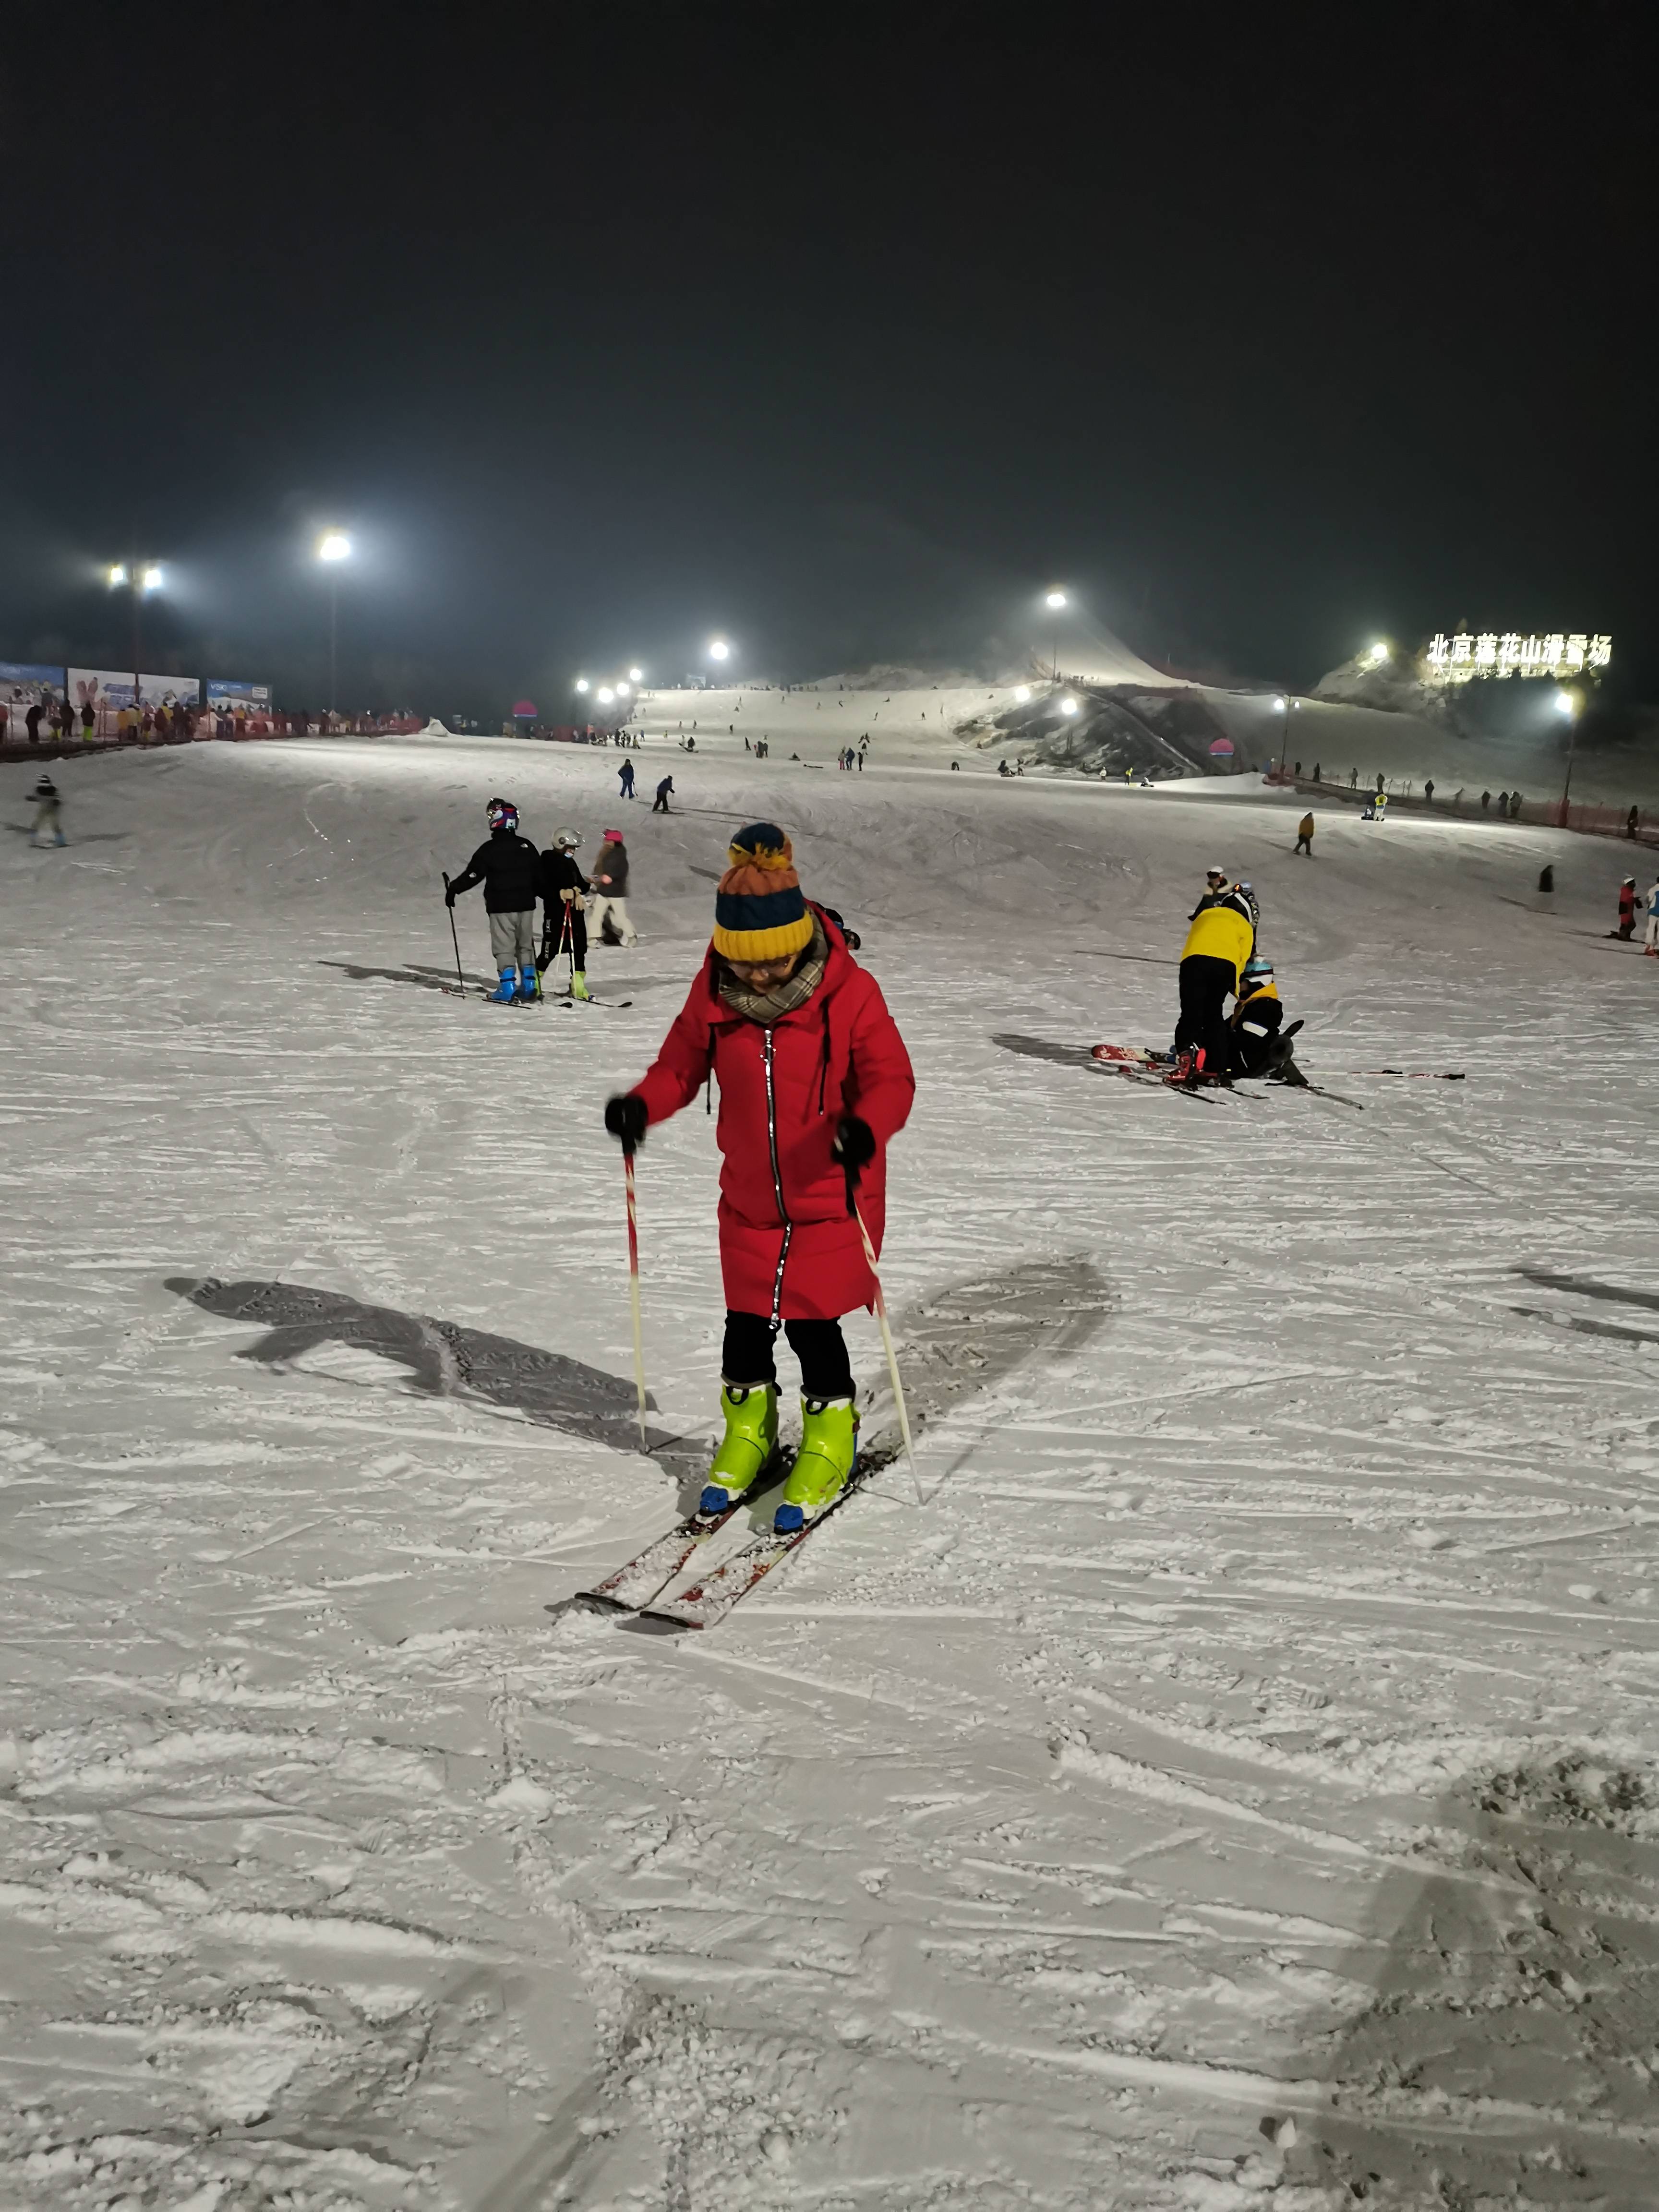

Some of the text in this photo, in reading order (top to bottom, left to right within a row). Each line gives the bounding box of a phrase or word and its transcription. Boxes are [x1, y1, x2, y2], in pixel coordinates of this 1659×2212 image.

[1427, 633, 1612, 664] 北京莲花山滑雪场
